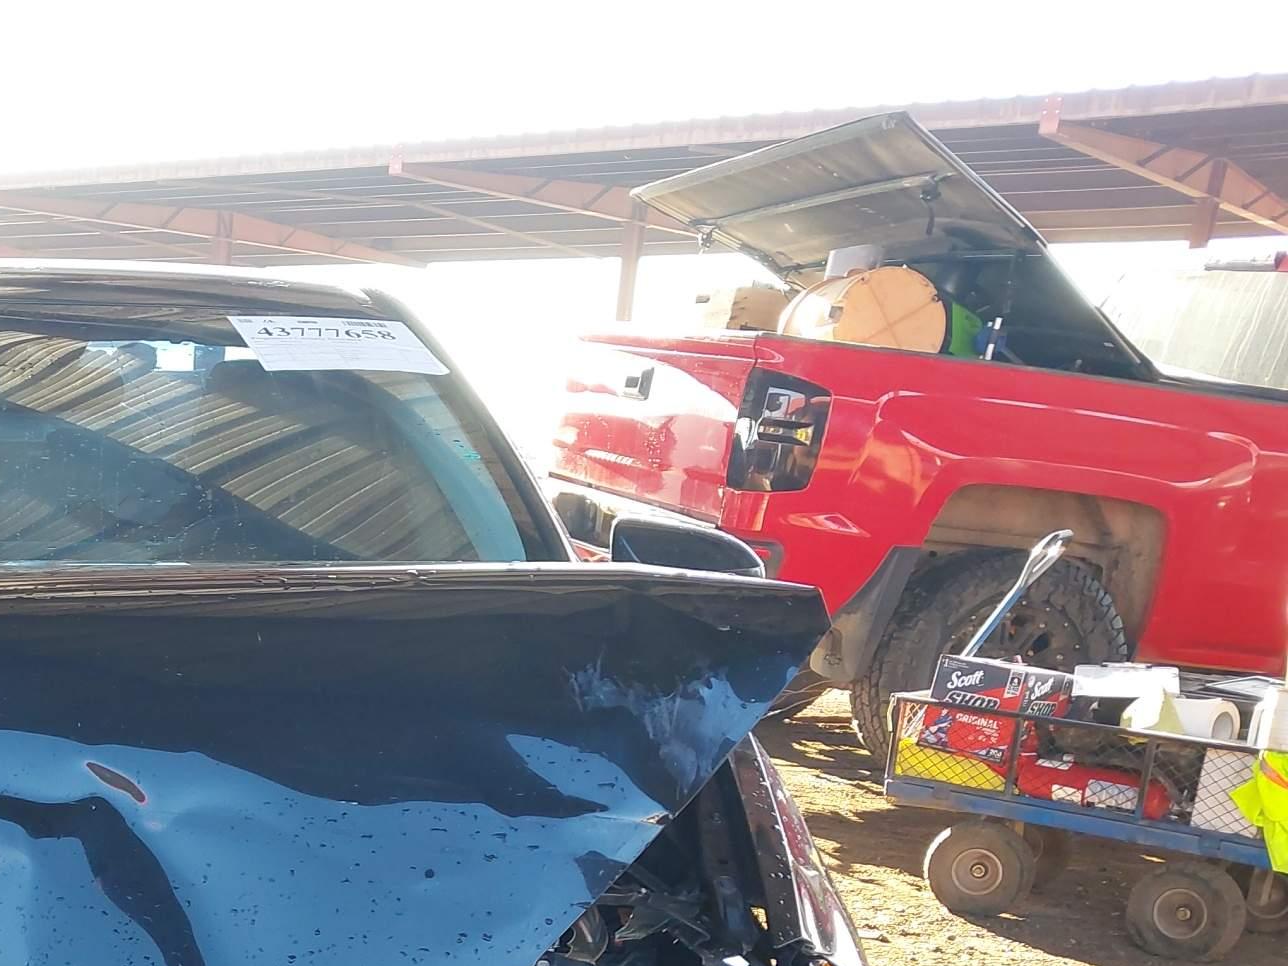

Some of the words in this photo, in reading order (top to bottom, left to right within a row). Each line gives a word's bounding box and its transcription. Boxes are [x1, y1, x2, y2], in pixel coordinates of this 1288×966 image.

[256, 327, 397, 341] 43777658
[946, 670, 985, 689] Scott
[1030, 676, 1055, 700] Scott
[955, 712, 999, 730] ORIGINAL
